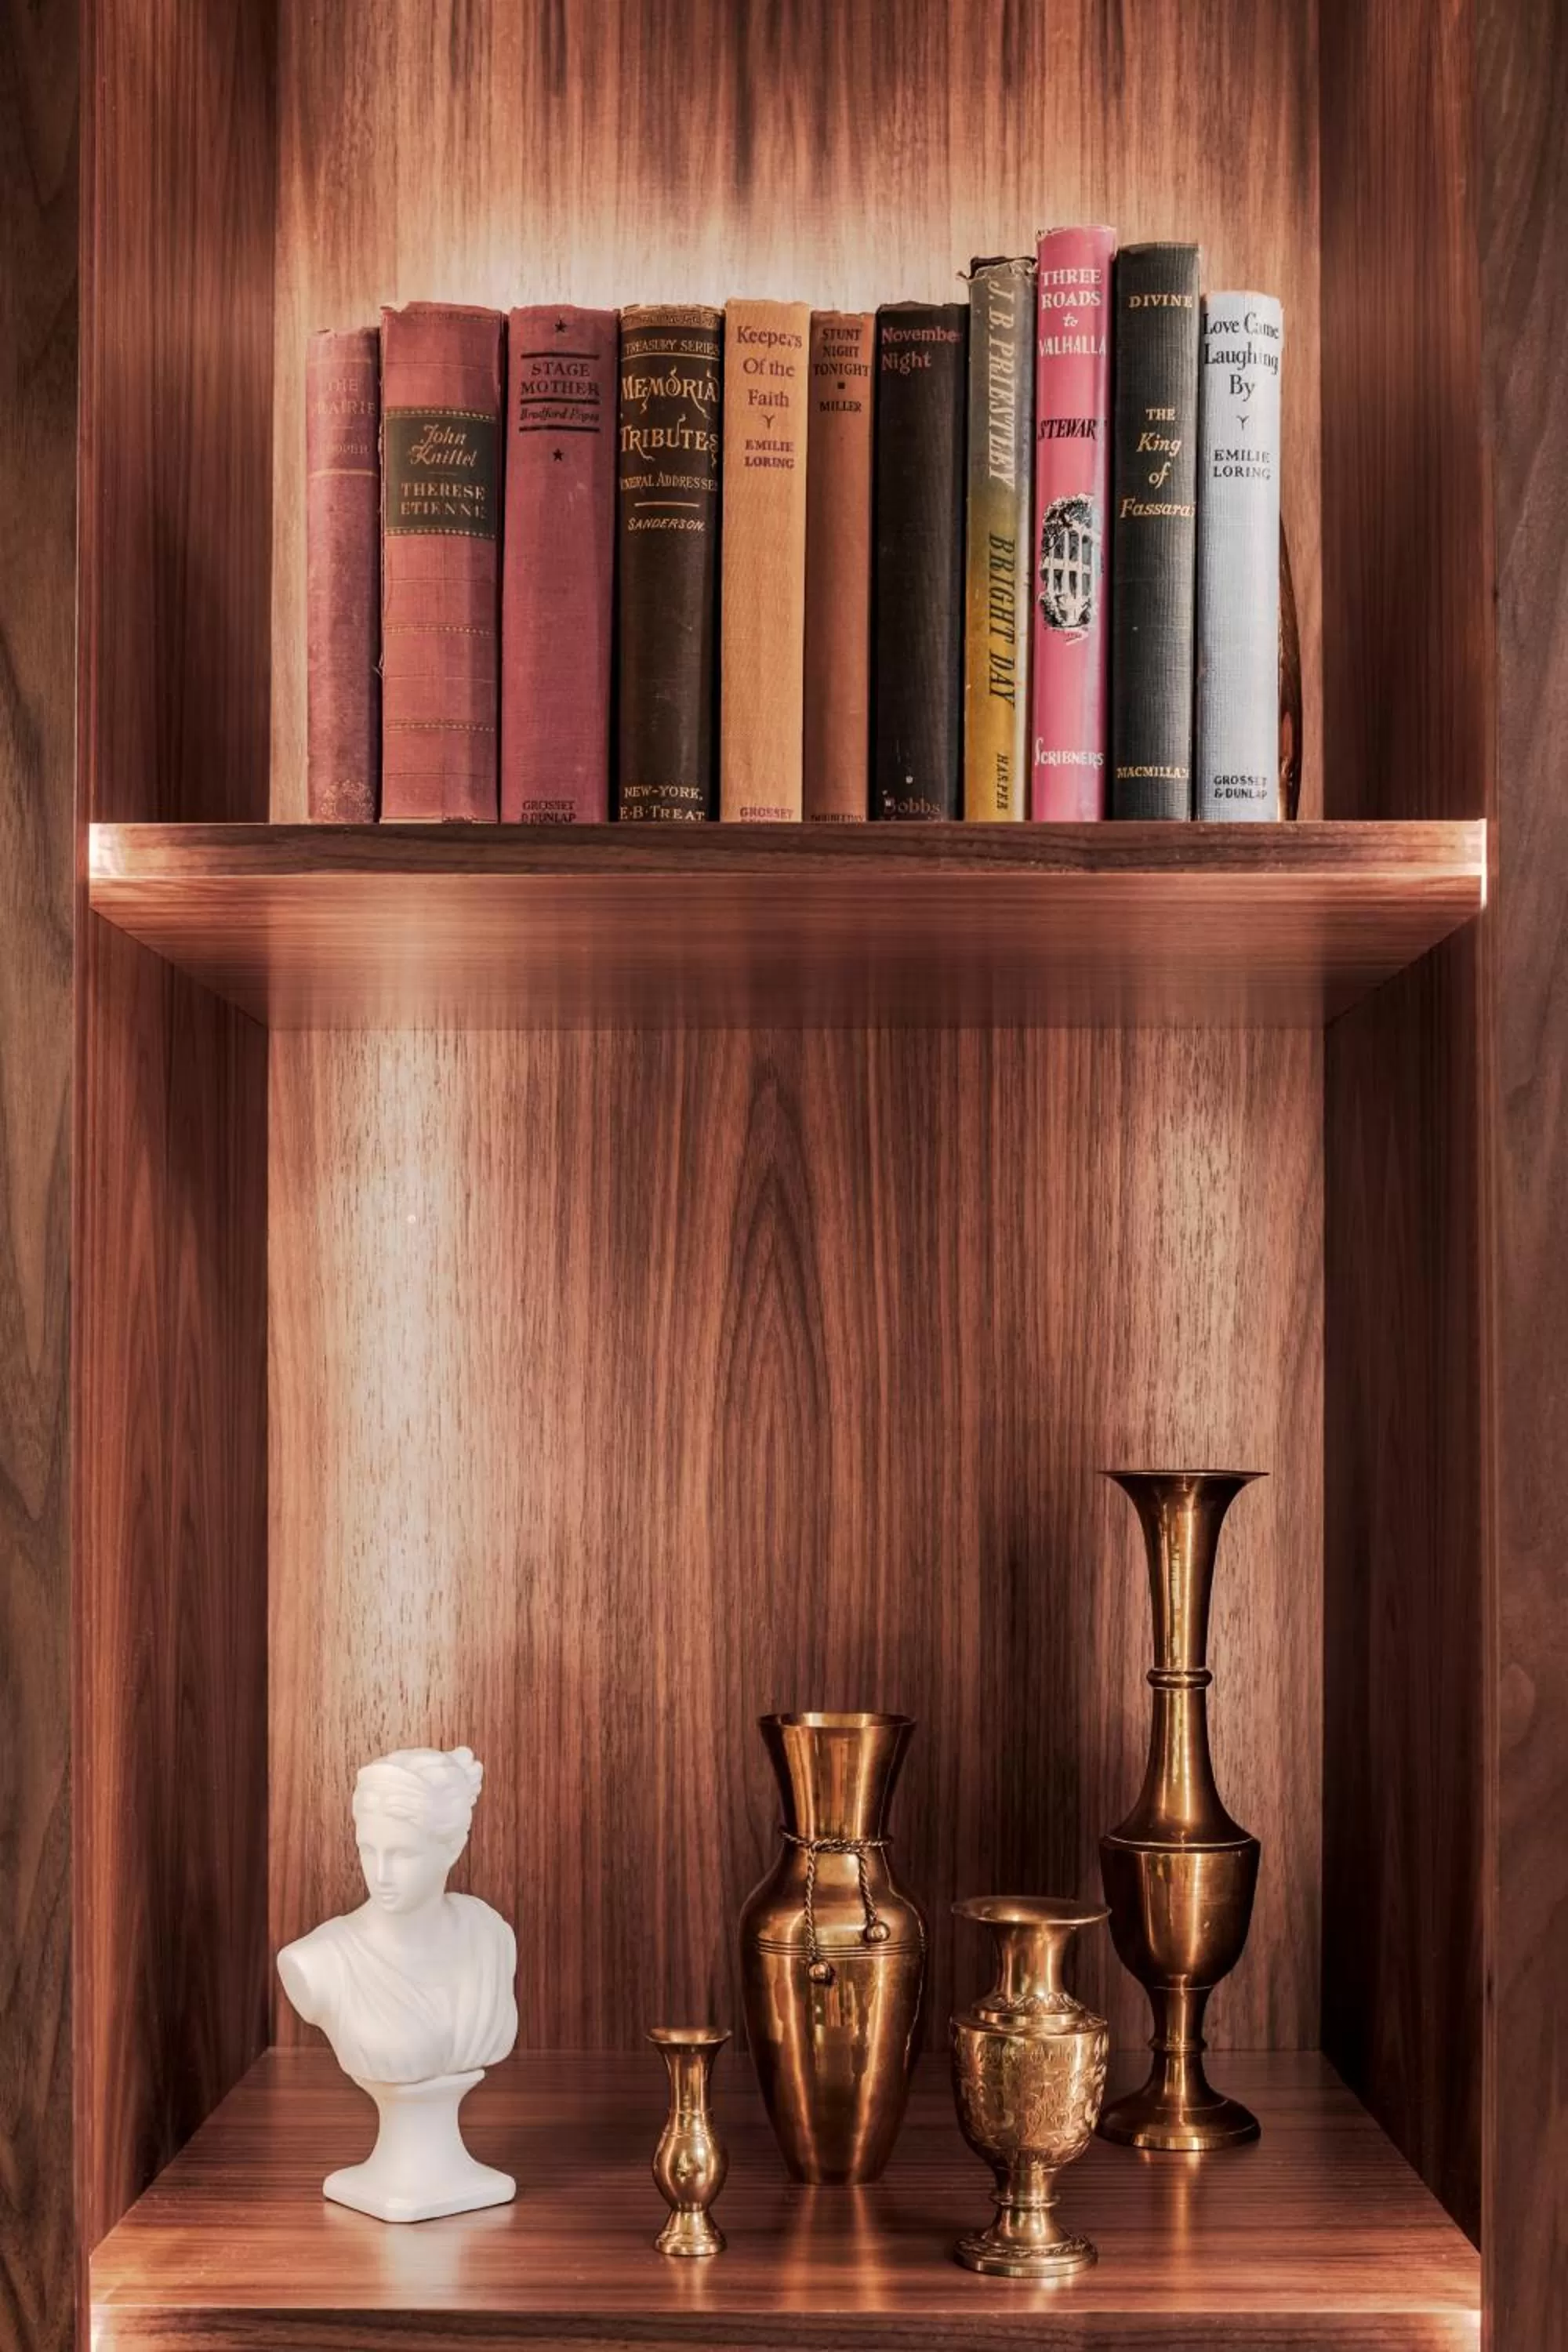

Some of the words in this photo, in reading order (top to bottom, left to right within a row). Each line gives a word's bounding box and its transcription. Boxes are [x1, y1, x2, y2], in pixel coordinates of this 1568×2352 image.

[1041, 269, 1101, 286] THREE
[1041, 291, 1101, 309] ROADS
[1129, 293, 1192, 308] DIVINE
[989, 307, 1014, 331] B.
[1062, 314, 1079, 327] to
[1203, 314, 1240, 336] Love
[1244, 312, 1279, 339] Came
[737, 325, 803, 348] Keepers
[822, 328, 862, 342] STUNT
[881, 325, 962, 345] Novembe
[822, 345, 860, 358] NIGHT
[1039, 335, 1106, 358] VALHALLA
[743, 358, 766, 376] Of
[769, 360, 796, 377] the
[881, 350, 931, 376] Night
[1205, 342, 1279, 376] Laughing
[531, 362, 590, 377] STAGE
[814, 363, 869, 377] TONIGHT
[520, 381, 601, 396] MOTHER
[1229, 374, 1255, 402] By
[748, 389, 789, 408] Faith
[819, 401, 862, 412] MILLER
[989, 336, 1015, 492] PRIESTLEY
[1145, 408, 1175, 421] THE
[419, 423, 467, 446] John
[619, 416, 719, 461] TRIBUTES
[1038, 418, 1107, 441] STEWAR
[745, 440, 794, 452] EMILIE
[1136, 433, 1181, 457] King
[744, 456, 795, 470] LORING
[1214, 449, 1271, 463] EMILIE
[1148, 462, 1170, 489] of
[1213, 466, 1271, 481] LORING
[401, 482, 486, 501] THERESE
[989, 531, 1015, 644] BRIGHT
[989, 648, 1015, 709] DAY
[996, 753, 1010, 811] HARPER
[1214, 775, 1268, 786] GROSSET
[1225, 789, 1268, 800] DUNLAP
[884, 797, 942, 815] Bobbs
